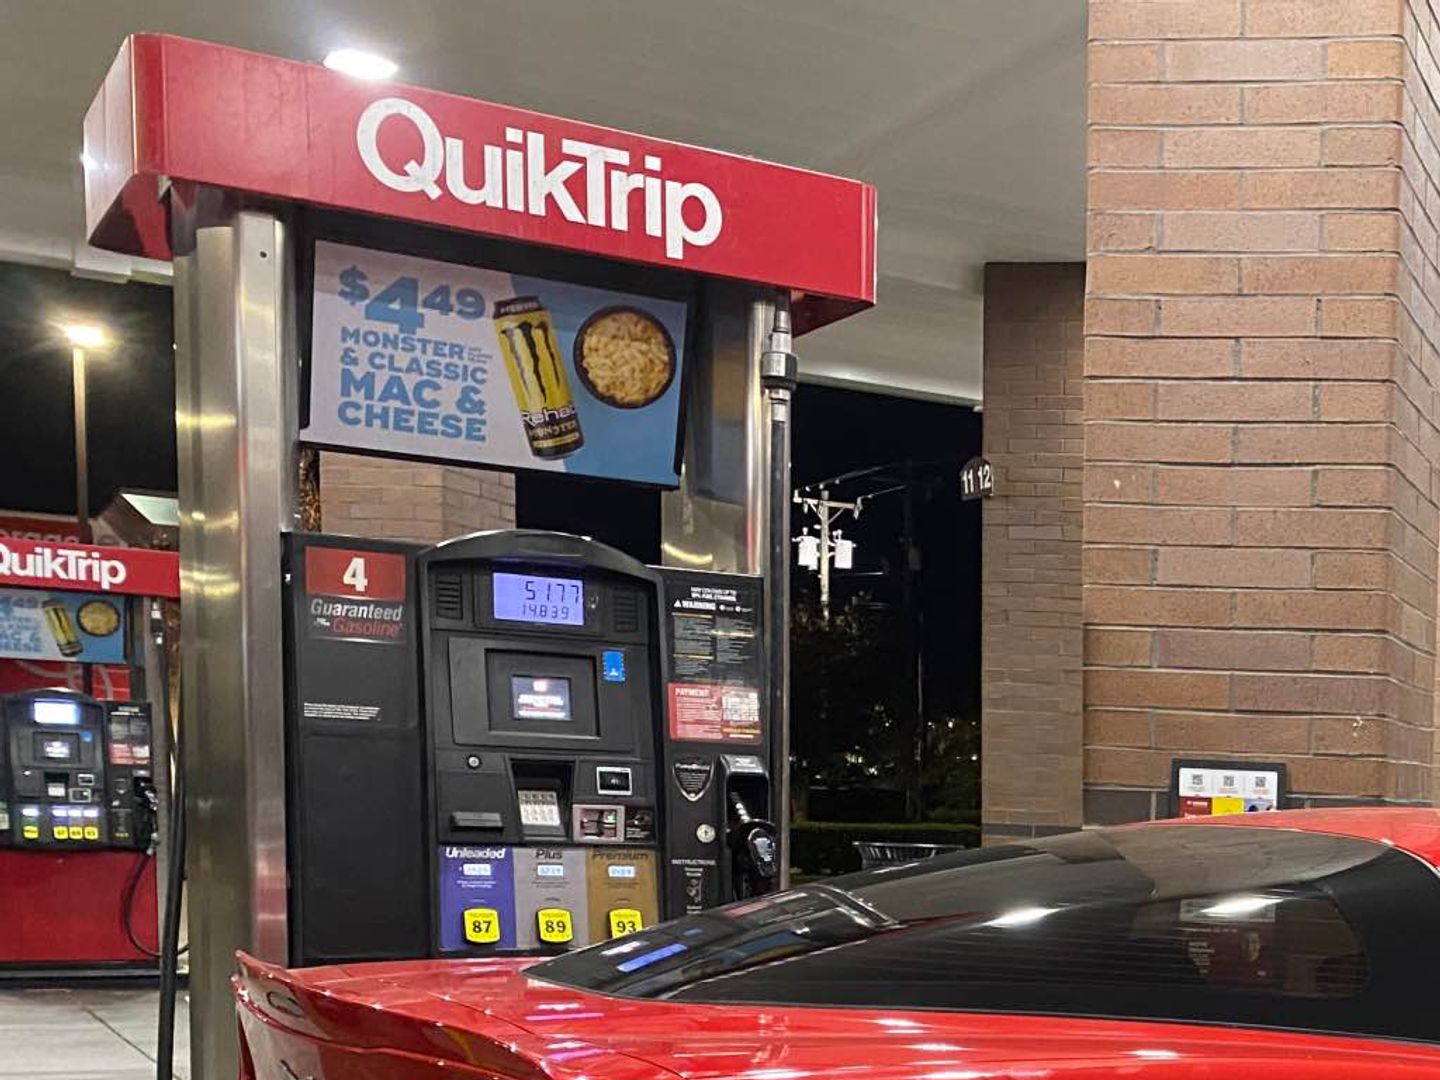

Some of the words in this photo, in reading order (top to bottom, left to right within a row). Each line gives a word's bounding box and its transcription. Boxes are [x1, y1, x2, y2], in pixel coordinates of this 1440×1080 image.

[356, 97, 723, 260] QuikTrip
[340, 326, 465, 361] MONSTER
[340, 347, 359, 367] &
[367, 351, 488, 385] CLASSIC
[340, 368, 462, 408] MAC
[455, 385, 487, 416] &
[337, 401, 487, 442] CHEESE
[962, 468, 975, 495] 11
[977, 464, 992, 490] 12
[343, 557, 368, 592] 4
[310, 598, 403, 621] Guaranteed
[332, 617, 400, 638] Gasoline
[446, 847, 506, 859] Unleaded
[535, 848, 563, 860] Plus
[472, 920, 492, 934] 87
[545, 920, 567, 934] 89
[616, 920, 637, 934] 93
